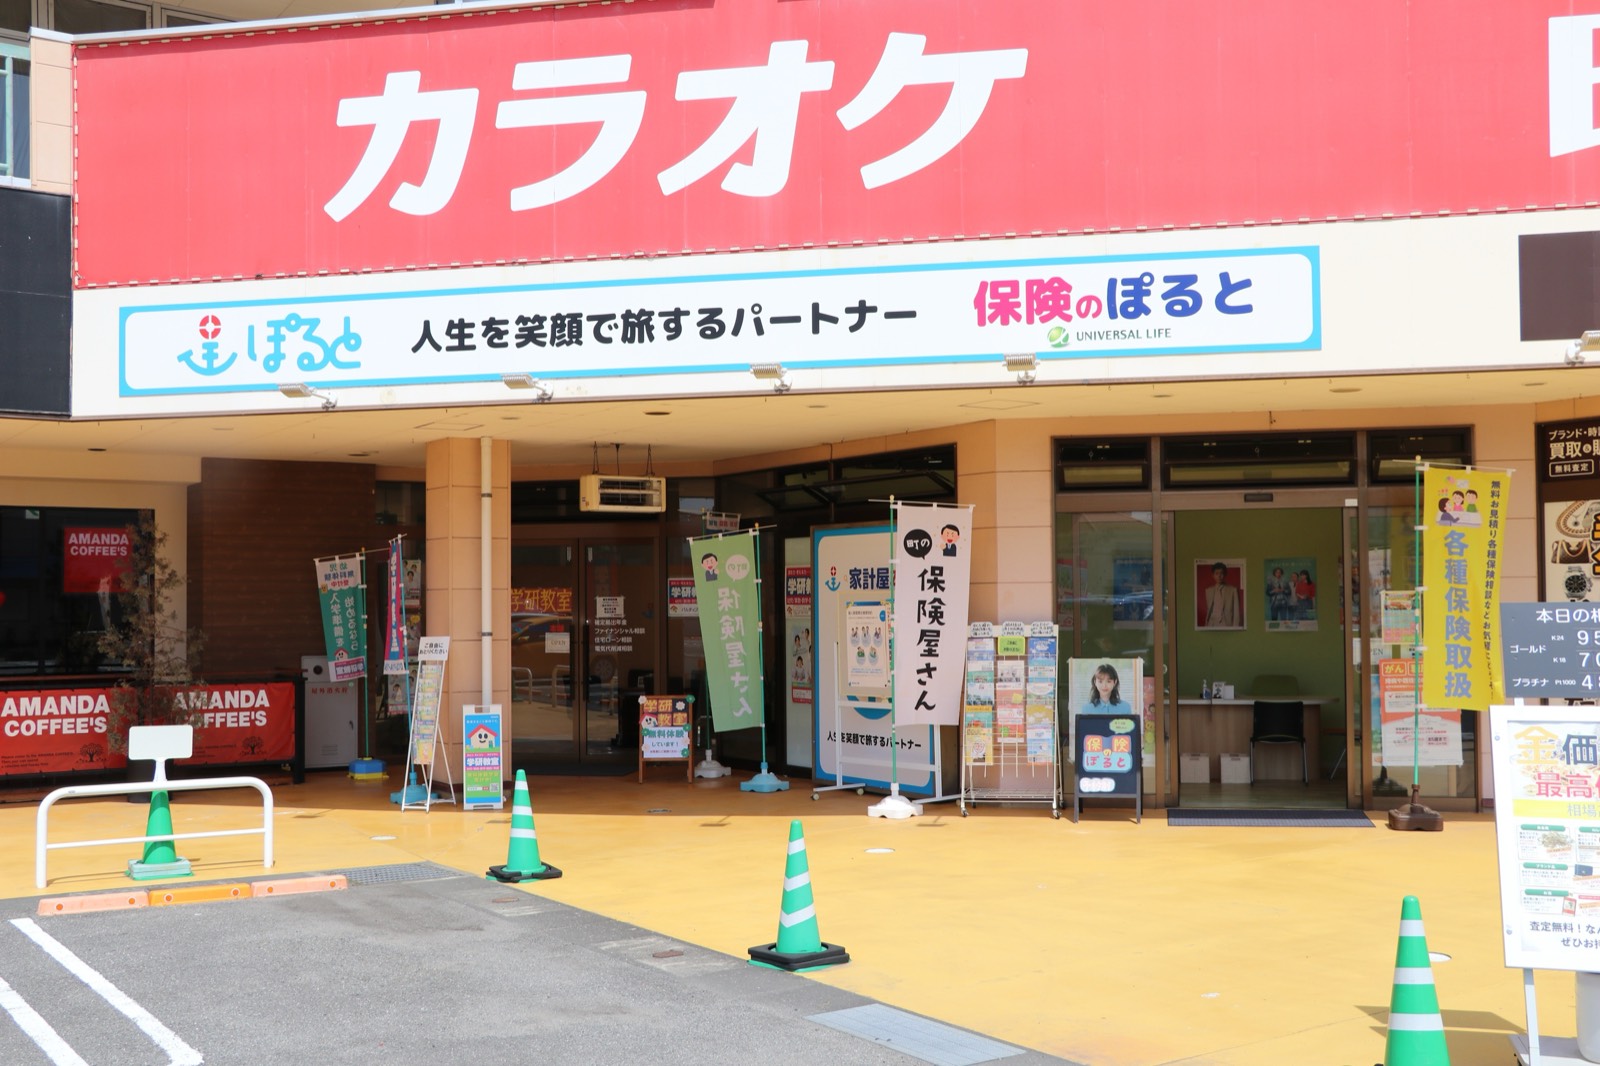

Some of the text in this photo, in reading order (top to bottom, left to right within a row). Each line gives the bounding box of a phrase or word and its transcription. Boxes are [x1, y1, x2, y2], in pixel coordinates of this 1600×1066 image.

[324, 32, 1029, 222] カラオケ
[974, 271, 1254, 328] 保険のぽると
[411, 299, 918, 355] 人生を笑顔で旅するパートナー
[1076, 328, 1172, 341] UNIVERSAL LIFE
[249, 312, 363, 374] ぽると
[1549, 426, 1600, 441] ブランド・時
[1554, 462, 1589, 474] 無料査定
[68, 533, 129, 545] AMANDA
[906, 538, 931, 551] 町の
[70, 546, 128, 556] COFFEE'S
[849, 567, 896, 591] 家計屋
[511, 588, 572, 612] 学研教室
[1444, 529, 1473, 699] 各種保険取扱
[594, 636, 633, 644] 住宅ローン相談
[914, 565, 946, 711] 保険屋さん
[1510, 644, 1547, 654] ゴールド
[1384, 664, 1405, 673] がん
[1512, 677, 1549, 688] プラチナ
[1, 695, 110, 717] AMANDA
[643, 699, 672, 713] 学研
[657, 712, 687, 726] 教室
[4, 717, 107, 737] COFFEE'S
[1513, 725, 1598, 766] 金価
[1535, 772, 1600, 799] 最高
[1567, 802, 1600, 817] 相場
